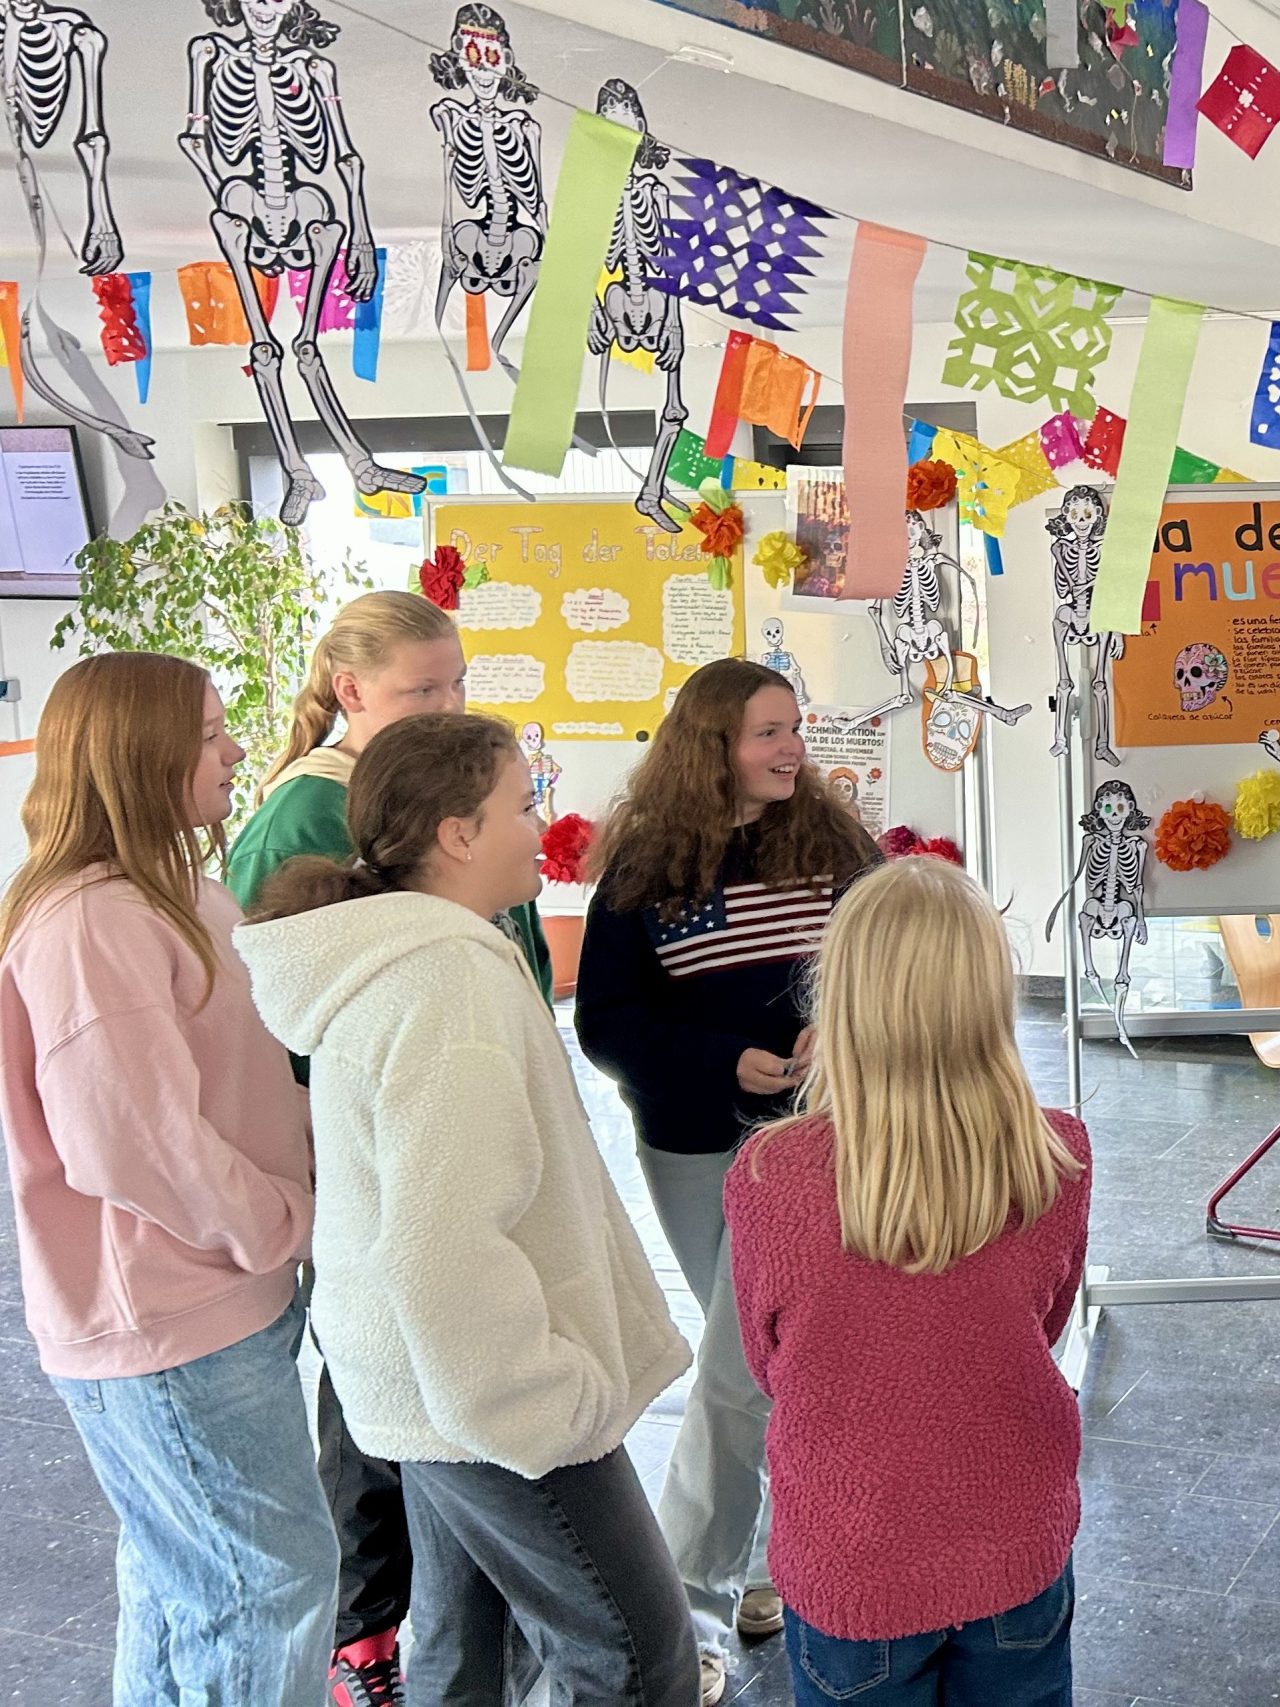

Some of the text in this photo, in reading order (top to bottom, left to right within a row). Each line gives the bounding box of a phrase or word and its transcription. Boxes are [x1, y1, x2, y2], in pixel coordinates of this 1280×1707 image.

[450, 528, 503, 562] Der
[508, 526, 562, 579] Tag
[582, 527, 622, 562] der
[1234, 636, 1248, 644] las
[805, 735, 817, 743] DÍA
[846, 738, 884, 746] MUERTOS!
